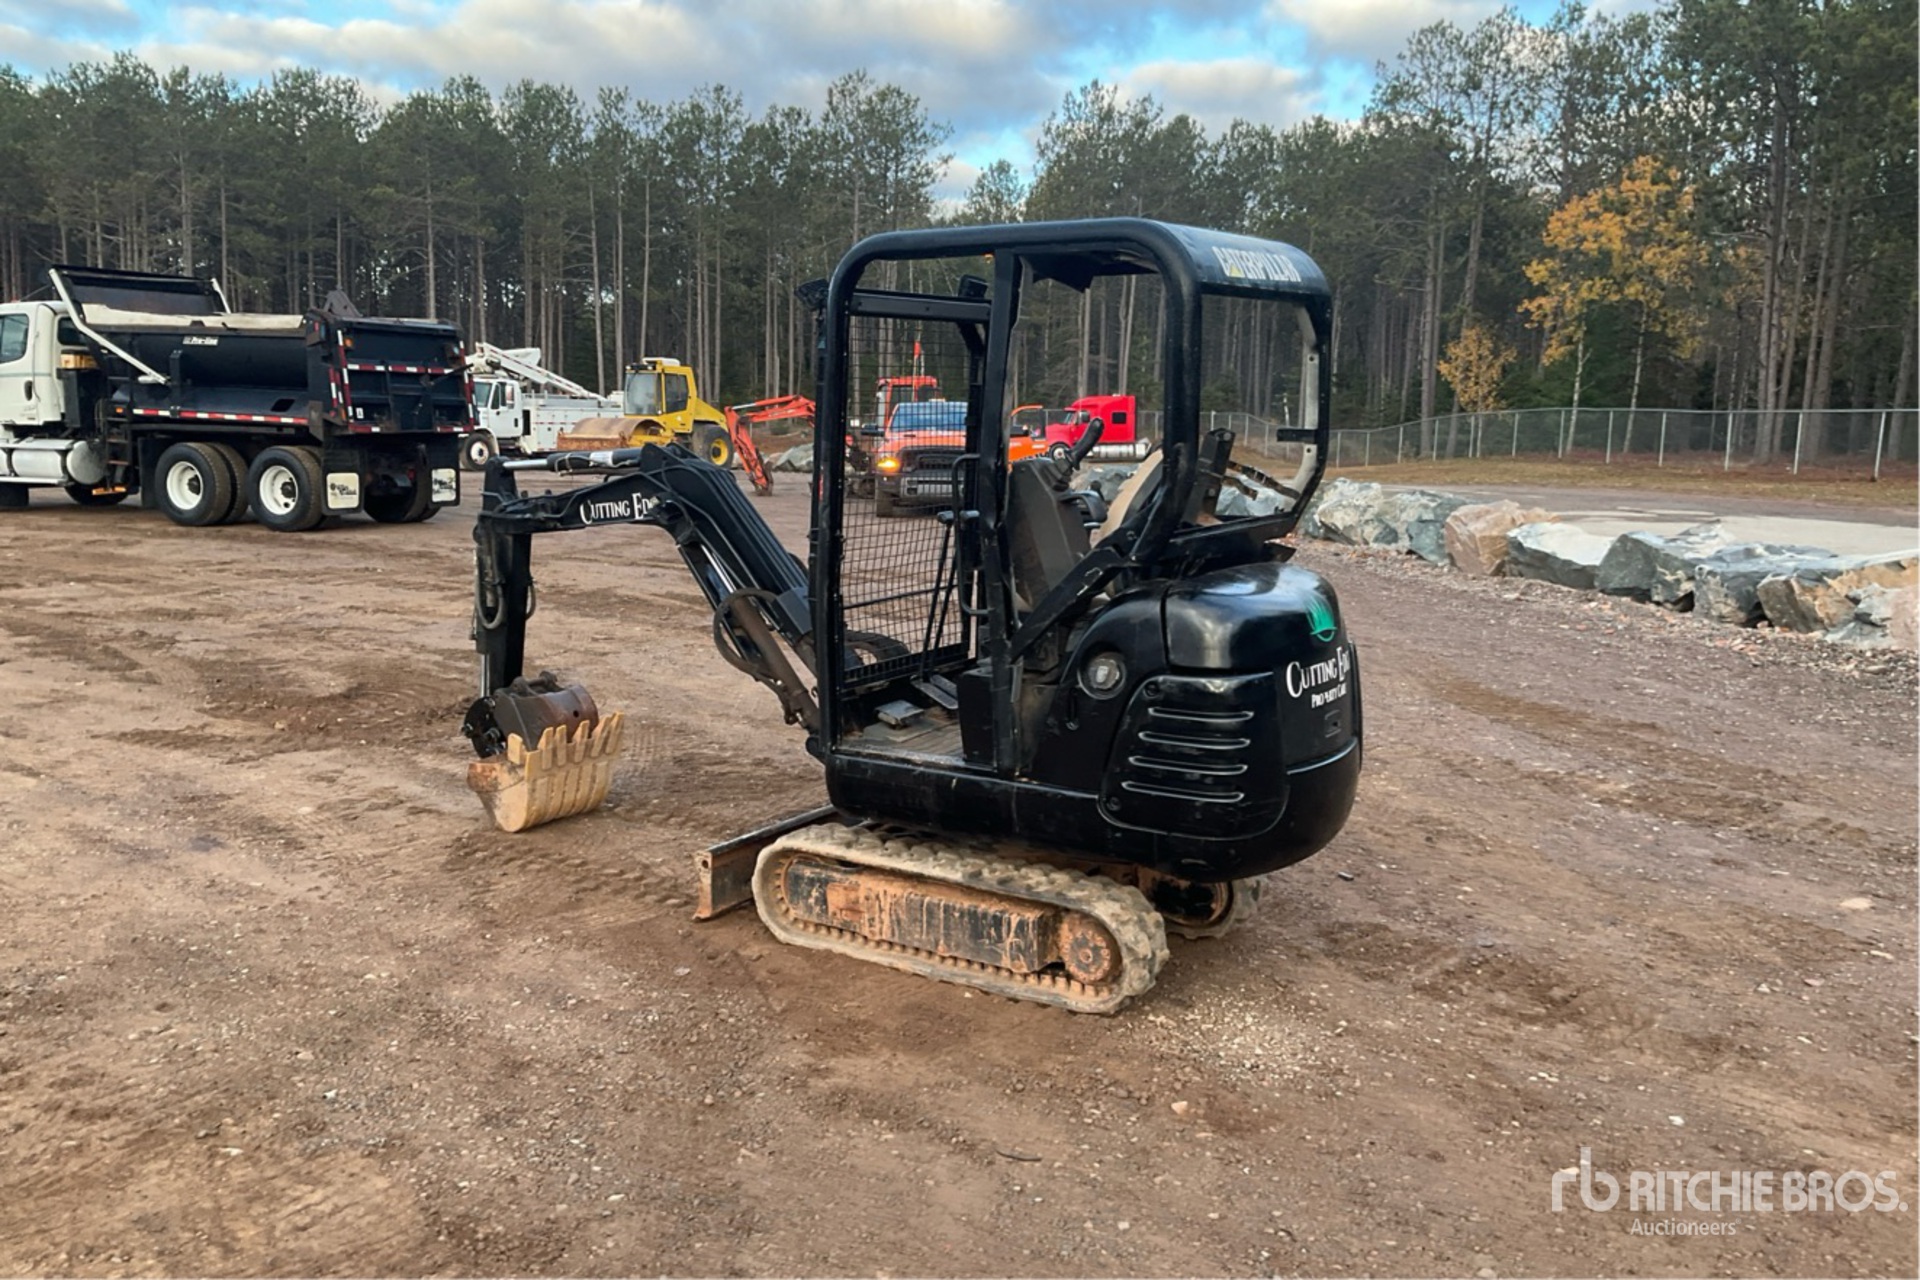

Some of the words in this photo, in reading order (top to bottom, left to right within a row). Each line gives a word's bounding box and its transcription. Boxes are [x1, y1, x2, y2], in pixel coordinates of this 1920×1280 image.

[1212, 245, 1302, 282] CATERPILLAR
[580, 499, 630, 525] CUTTING
[1286, 658, 1337, 698] CUTTING
